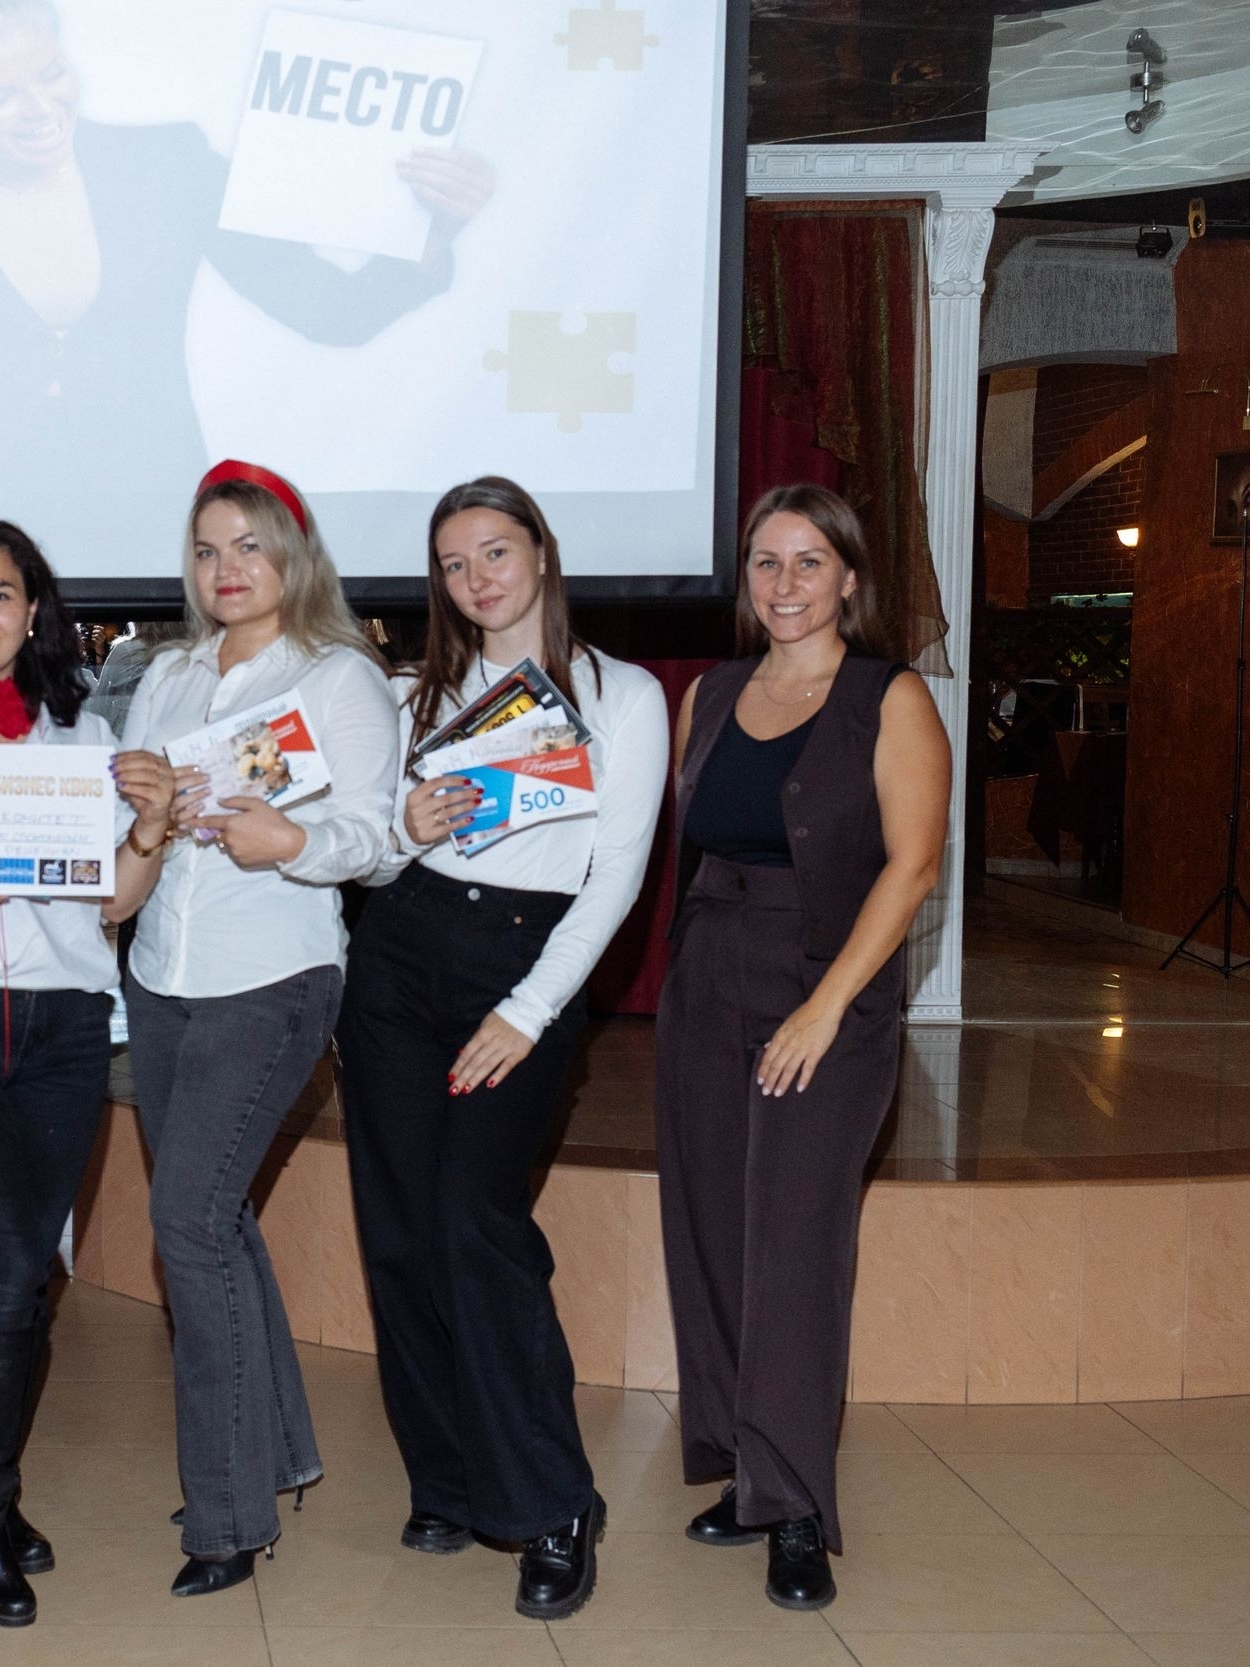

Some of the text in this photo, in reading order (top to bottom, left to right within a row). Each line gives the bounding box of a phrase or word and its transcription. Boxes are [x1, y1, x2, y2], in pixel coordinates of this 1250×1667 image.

[250, 50, 465, 137] МЕСТО
[59, 776, 104, 798] КВИЗ
[520, 787, 565, 812] 500
